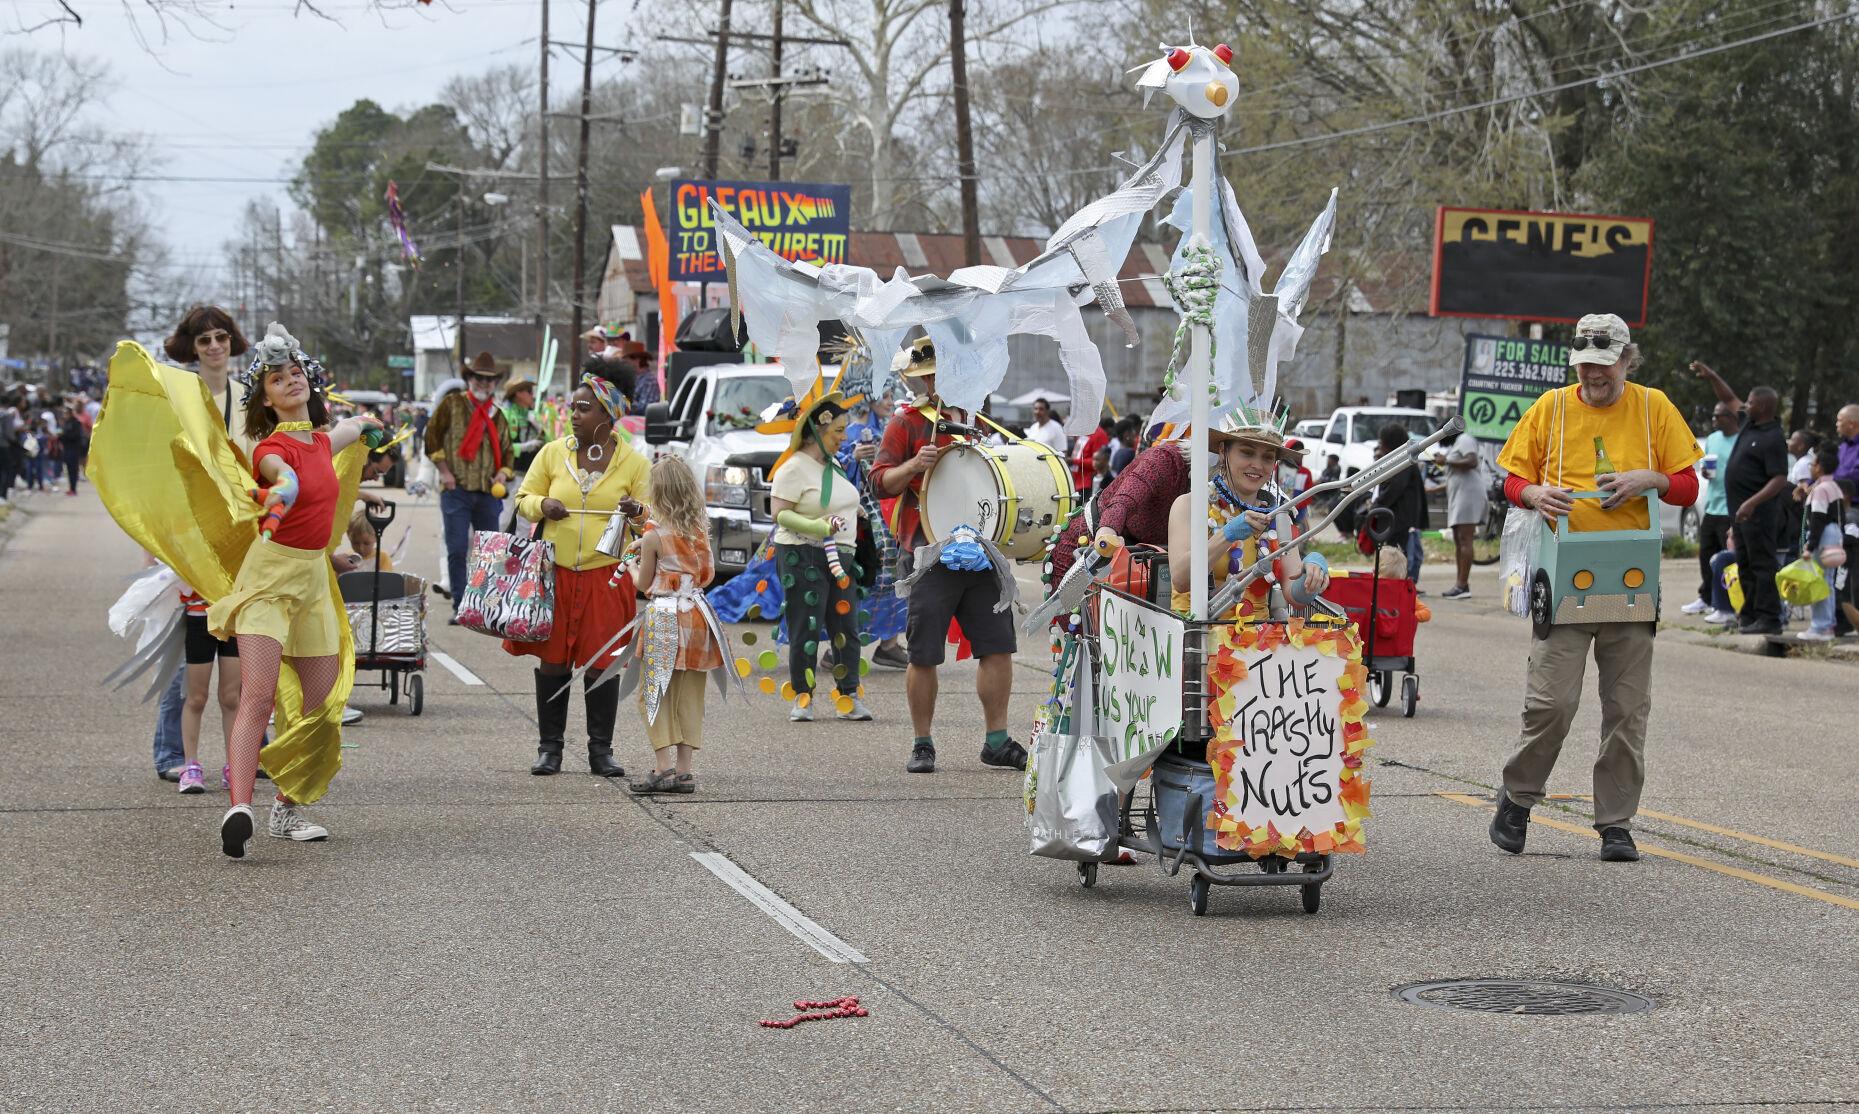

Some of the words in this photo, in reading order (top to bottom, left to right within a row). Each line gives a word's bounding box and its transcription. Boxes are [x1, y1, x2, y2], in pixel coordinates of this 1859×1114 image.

[677, 184, 808, 229] GLEAUX
[678, 231, 709, 252] TO
[677, 250, 716, 275] THE
[1496, 340, 1526, 362] FOR
[1530, 344, 1568, 366] SALE
[1248, 653, 1328, 699] THE
